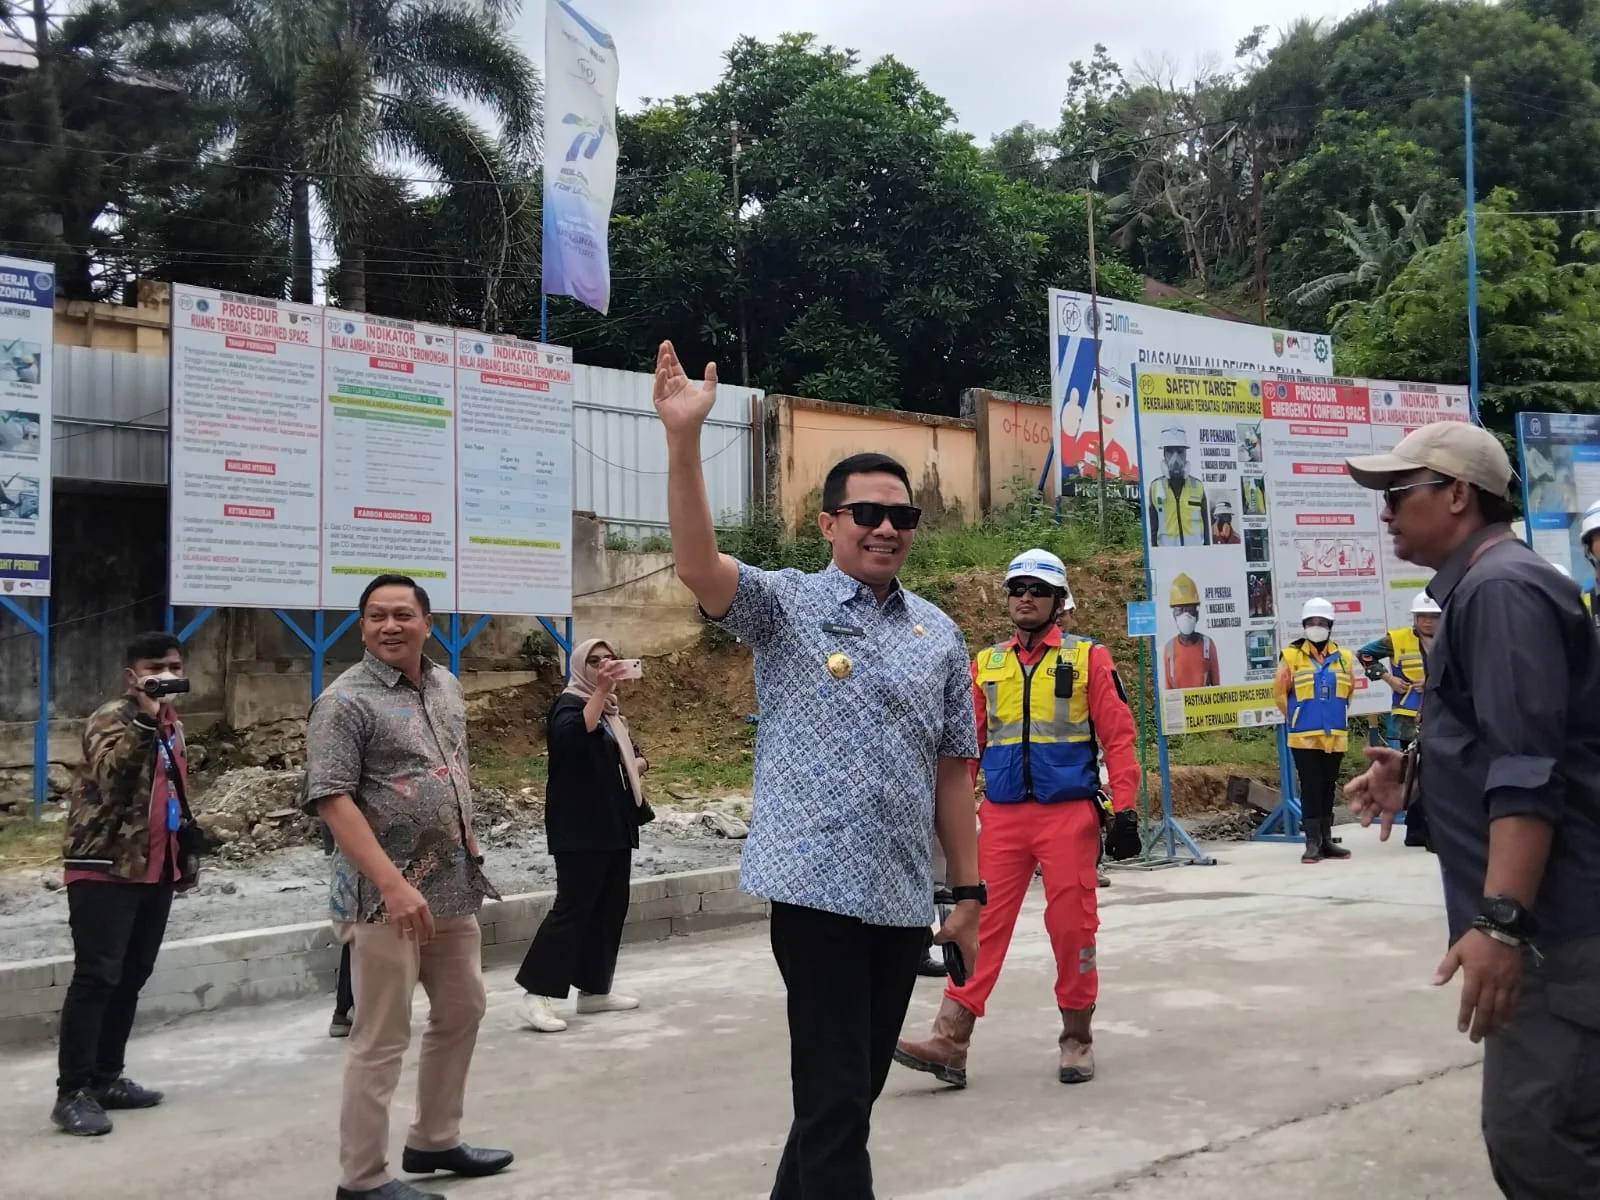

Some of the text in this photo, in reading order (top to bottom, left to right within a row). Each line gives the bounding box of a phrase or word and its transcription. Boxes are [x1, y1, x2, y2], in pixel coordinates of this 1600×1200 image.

[222, 302, 278, 324] PROSEDUR
[191, 314, 309, 343] RUANG TERBATAS CONFINED SPACE
[366, 325, 416, 345] INDIKATOR
[332, 336, 449, 364] NILAI AMBANG BATAS GAS TEROWONGAN
[494, 346, 539, 363] INDIKATOR
[460, 355, 570, 382] NILAI AMBANG BATAS GAS TEROWONGAN
[1166, 378, 1237, 396] SAFETY TARGET
[1295, 386, 1337, 402] PROSEDUR
[1143, 397, 1261, 414] PEKERJAAN RUANG TERBATAS CONFINED SPACE
[1400, 393, 1439, 409] INDIKATOR
[1271, 402, 1366, 421] EMERGENCY CONFINED SPACE
[1210, 429, 1236, 443] PENGAWAS
[1184, 693, 1211, 706] PASTIKAN
[1213, 691, 1238, 705] CONFINED
[1240, 689, 1255, 702] SPACE
[1186, 712, 1238, 728] TELAH TERVALIDASI
